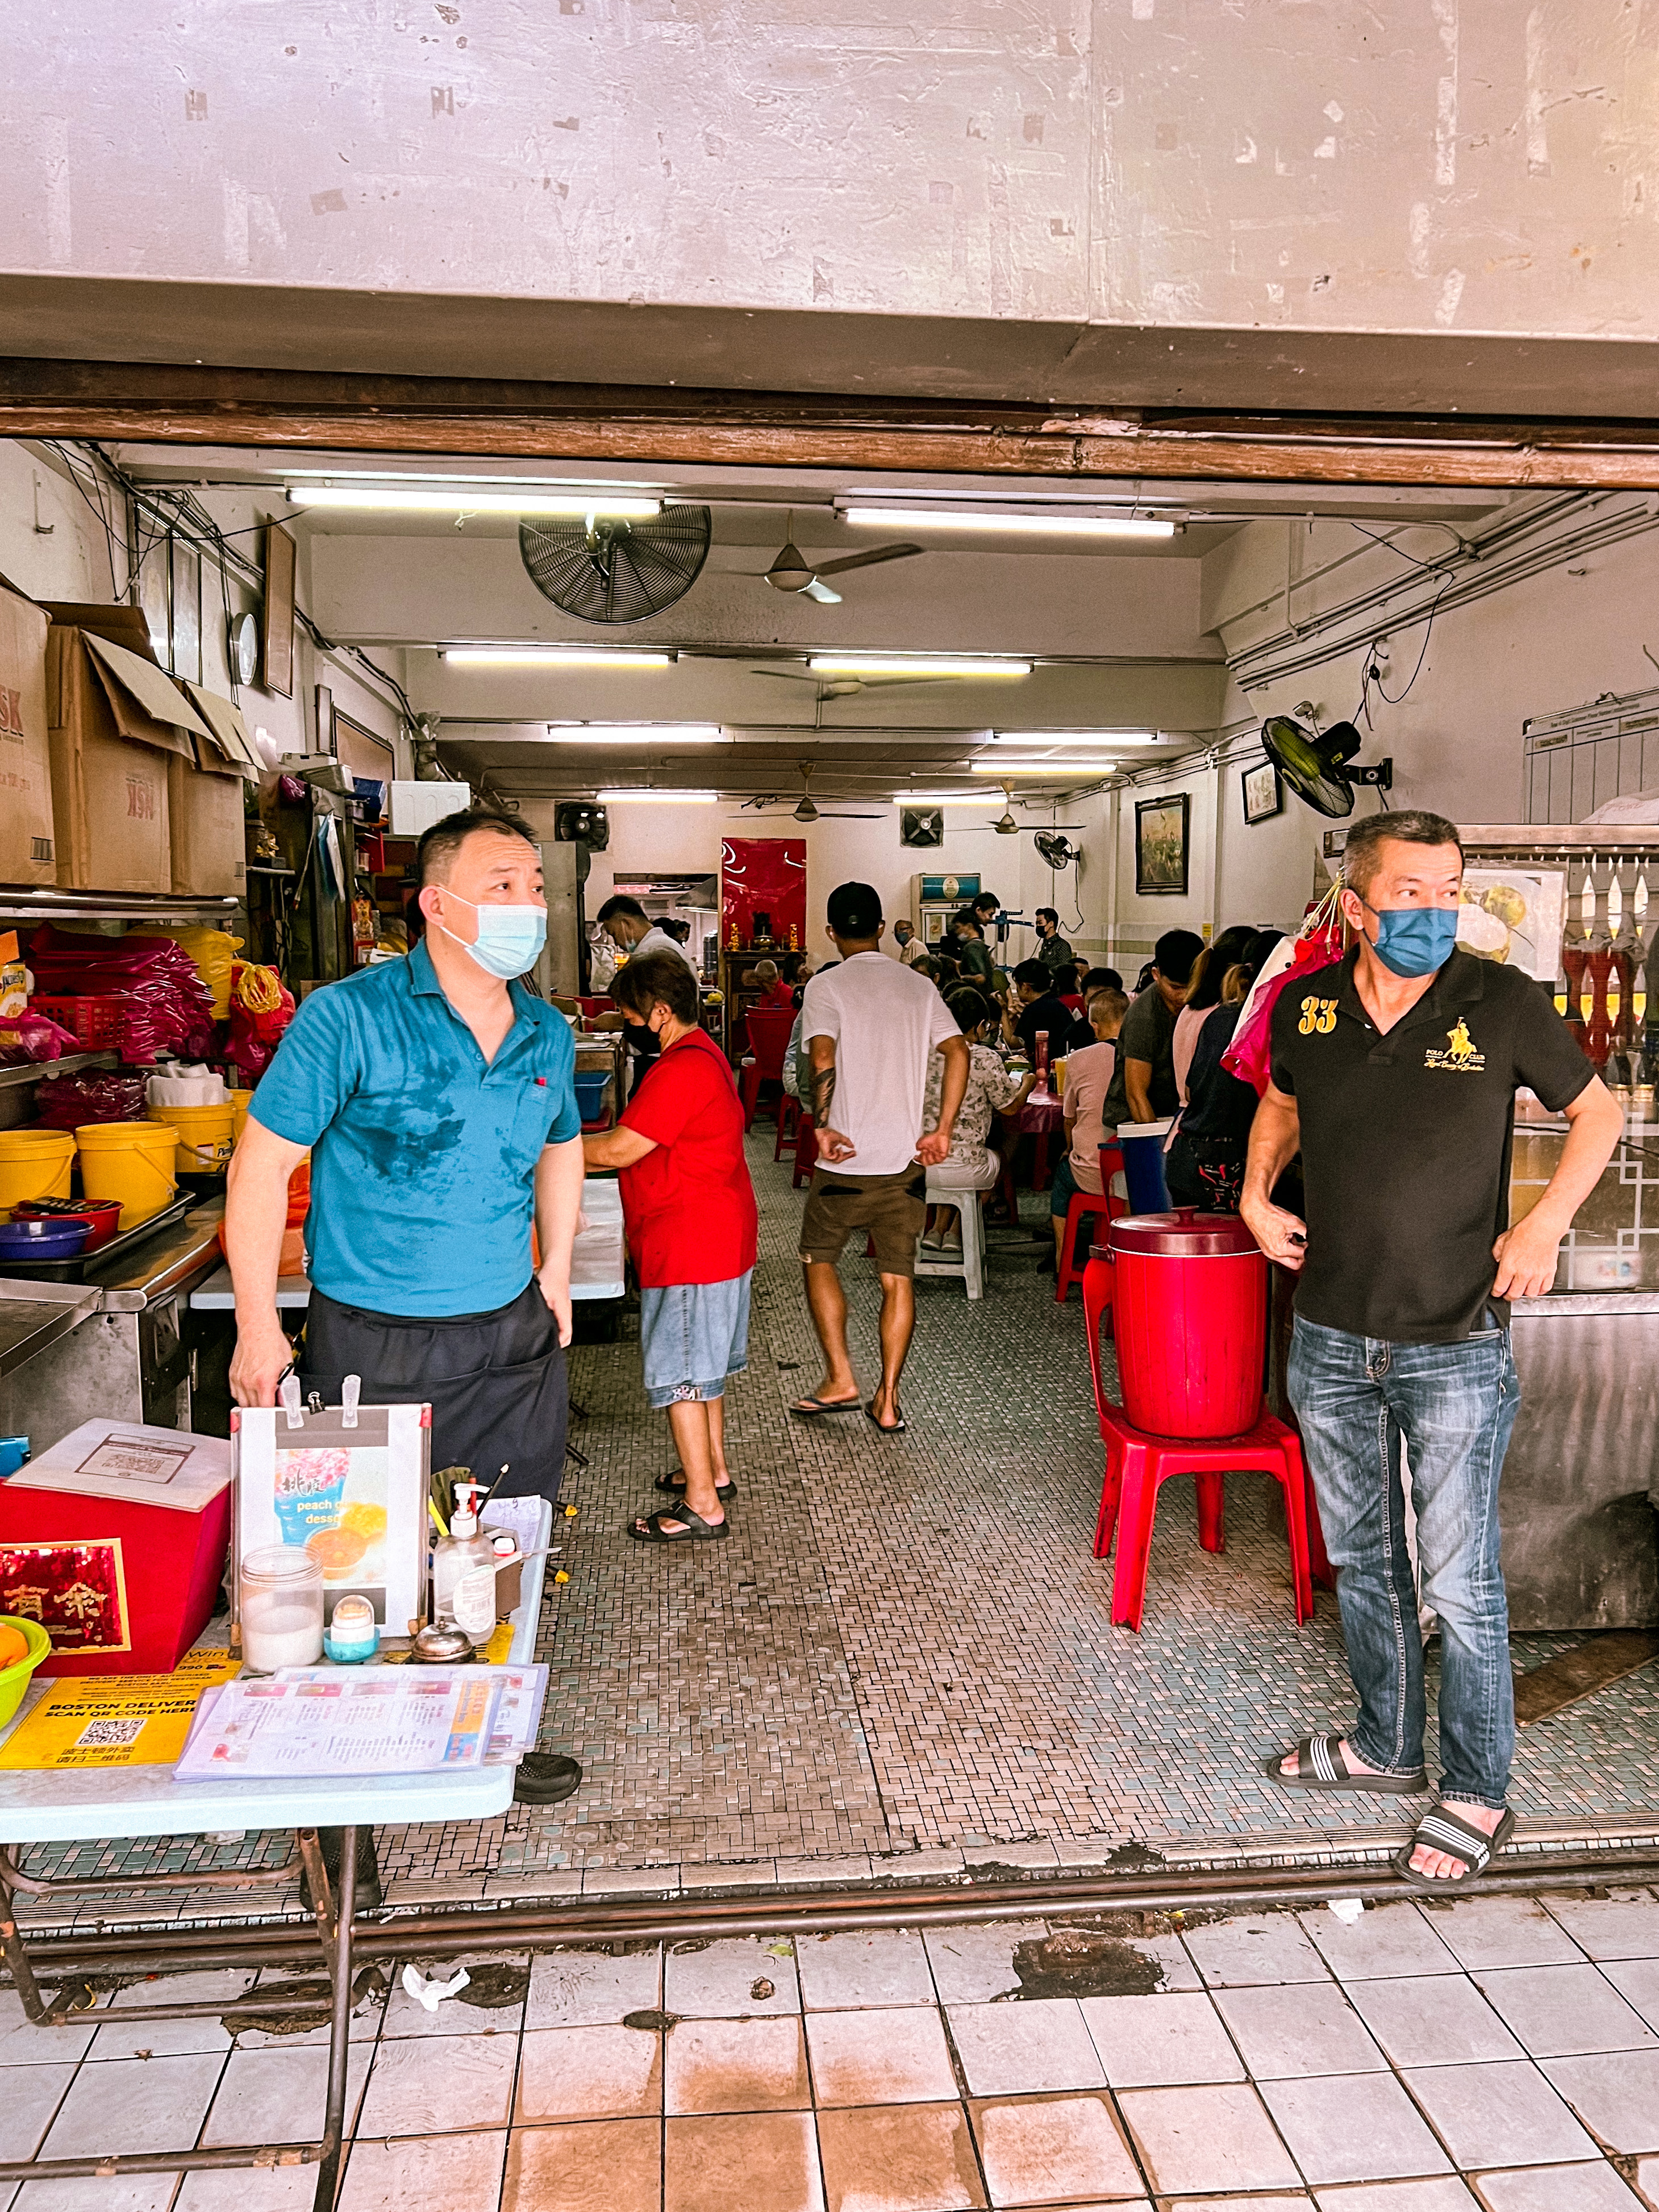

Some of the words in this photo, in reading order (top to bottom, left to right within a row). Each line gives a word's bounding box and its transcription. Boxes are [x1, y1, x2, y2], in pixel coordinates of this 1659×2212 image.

[1298, 995, 1339, 1035] 33
[297, 1499, 332, 1513] peach
[124, 1700, 197, 1708] DELIVER
